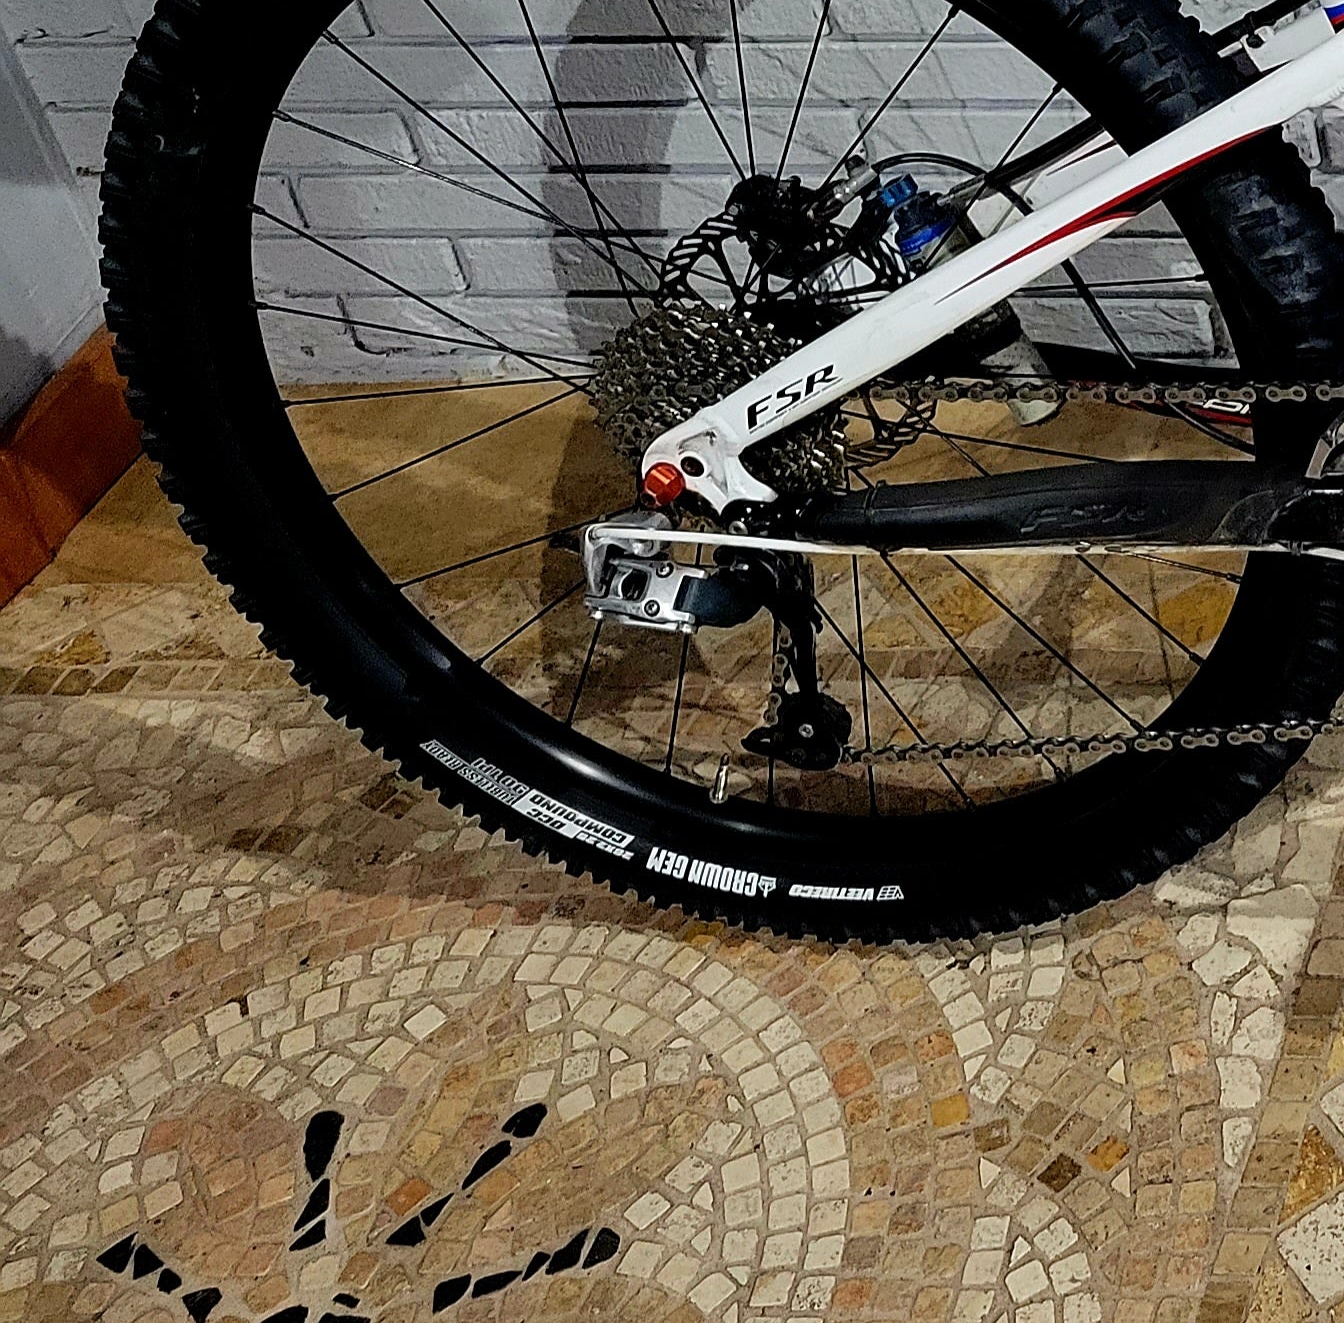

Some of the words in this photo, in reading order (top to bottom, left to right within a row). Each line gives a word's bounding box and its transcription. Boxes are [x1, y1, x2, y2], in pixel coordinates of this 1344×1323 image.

[747, 364, 839, 430] FSR
[420, 740, 460, 770] READY
[457, 765, 519, 806] TUBELESS
[529, 794, 627, 843] COMPOUND
[646, 847, 688, 879] GEM
[688, 860, 759, 896] CROWN
